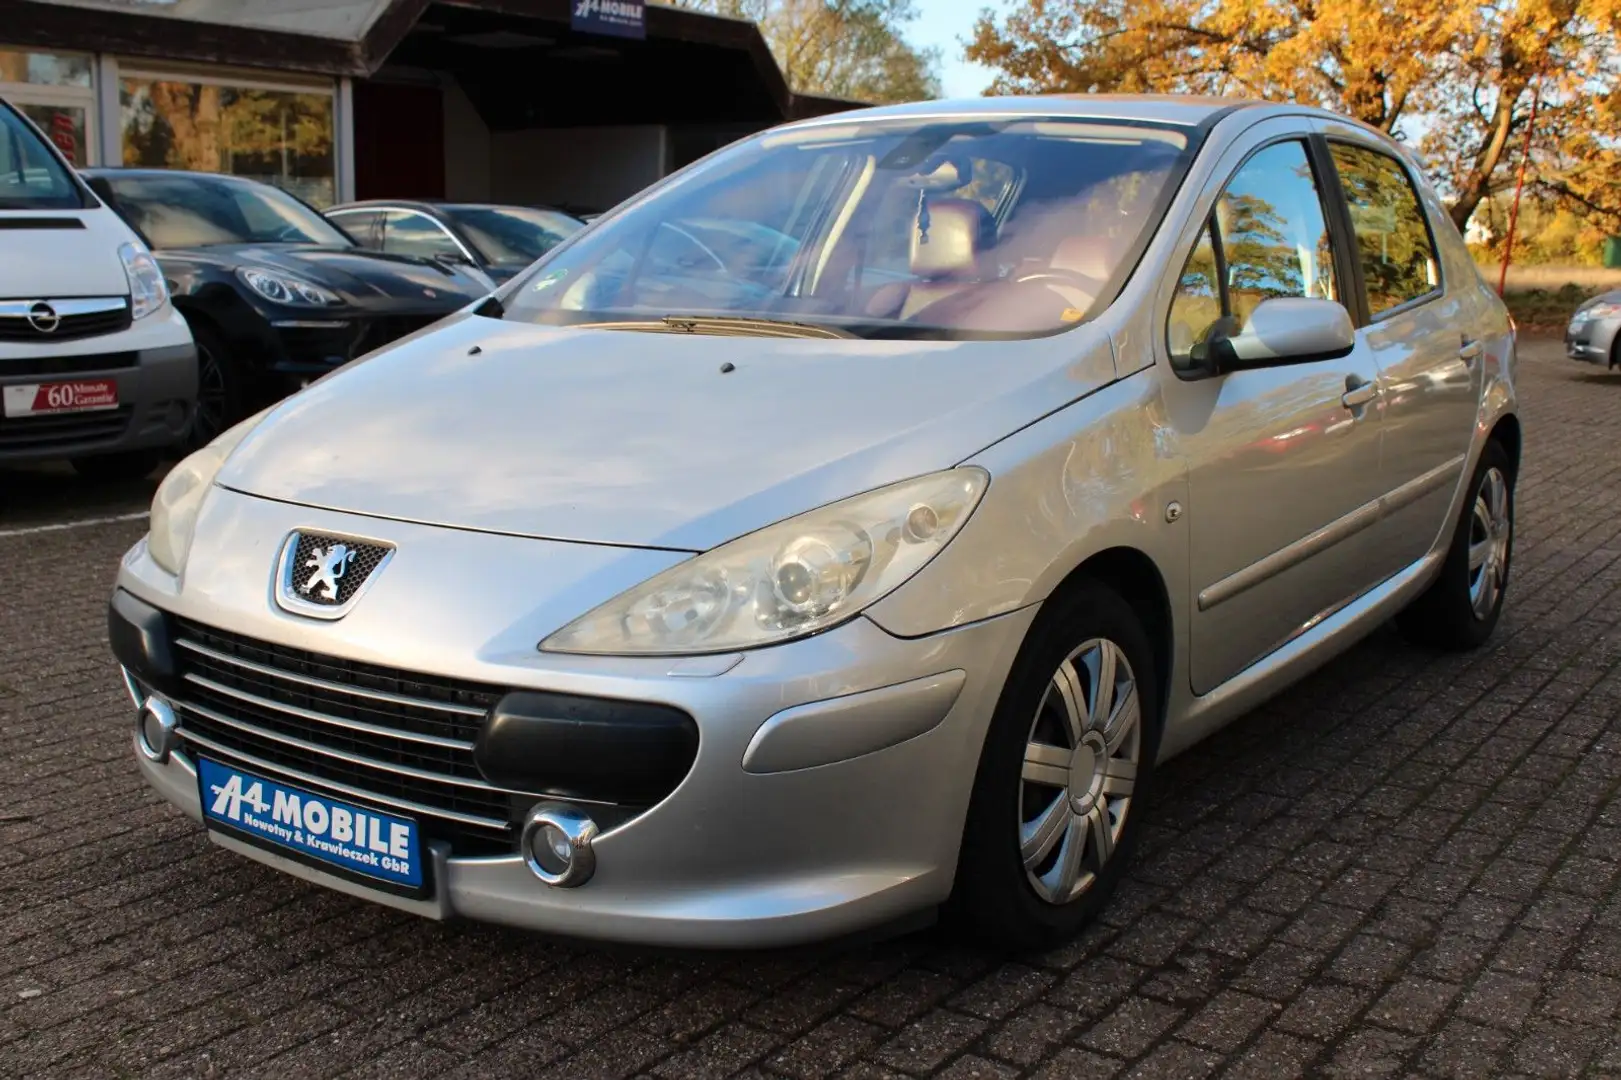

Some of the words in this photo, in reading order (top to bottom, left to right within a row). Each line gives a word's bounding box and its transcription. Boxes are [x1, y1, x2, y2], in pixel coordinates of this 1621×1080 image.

[601, 0, 643, 19] MOBILE
[48, 384, 73, 407] 60
[74, 383, 108, 394] Monate
[272, 790, 410, 859] MOBILE
[243, 812, 293, 842] Nowotny
[294, 832, 304, 844] &
[306, 835, 378, 866] Krawieczek
[381, 857, 410, 876] GbR
